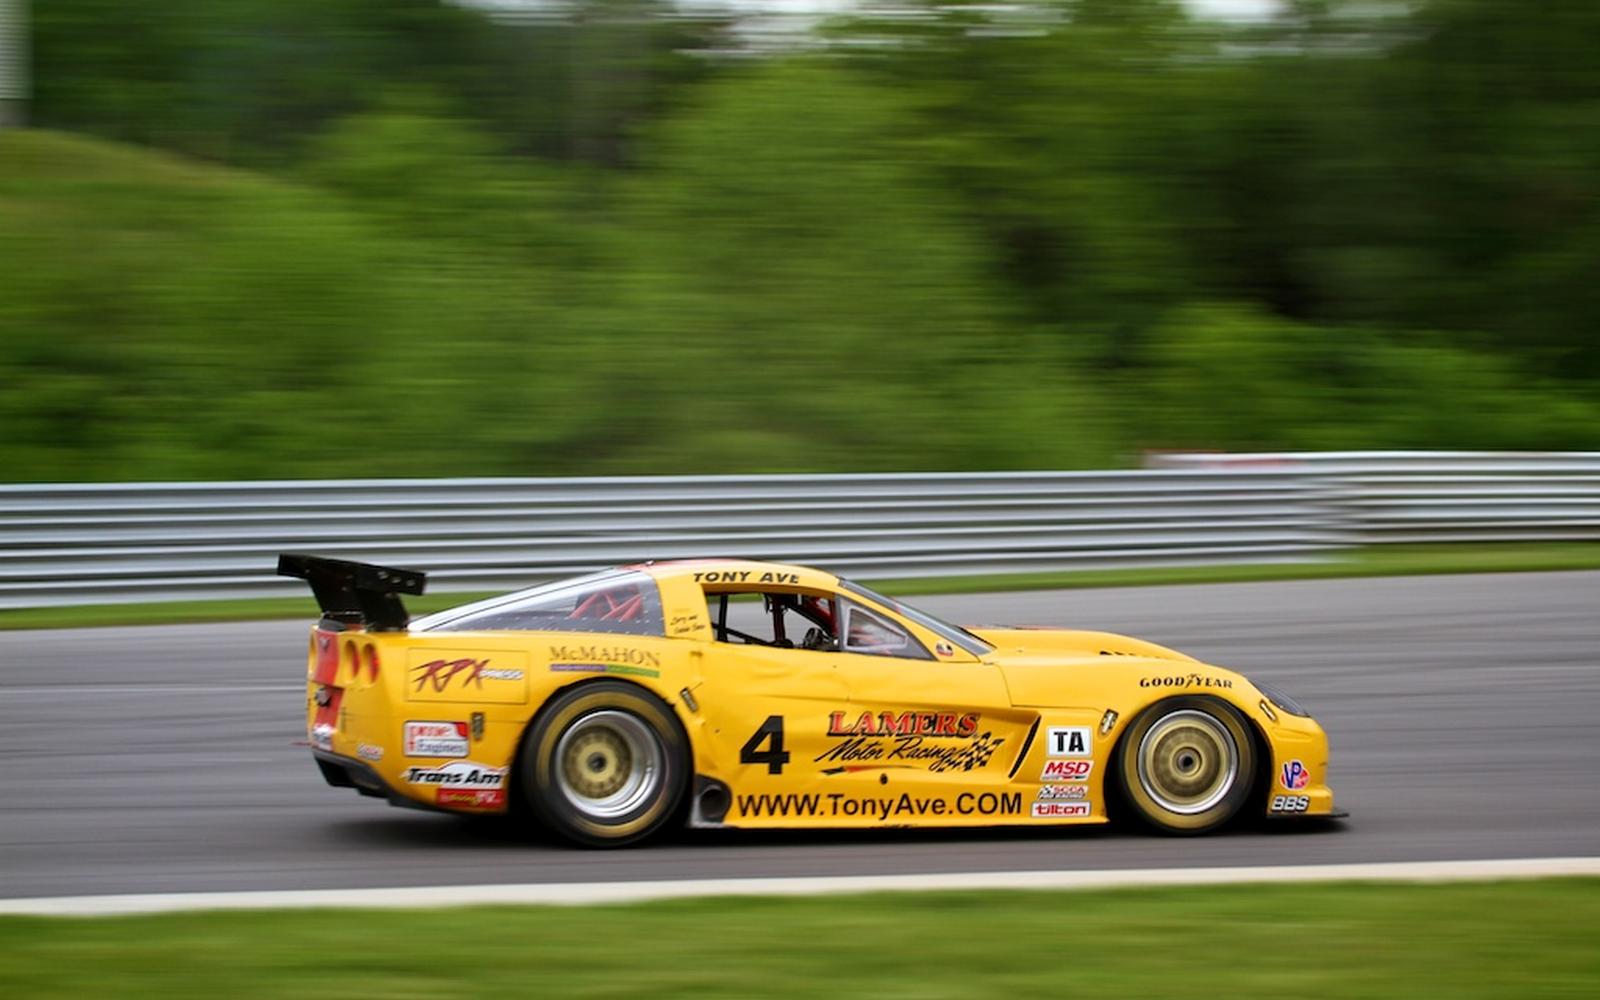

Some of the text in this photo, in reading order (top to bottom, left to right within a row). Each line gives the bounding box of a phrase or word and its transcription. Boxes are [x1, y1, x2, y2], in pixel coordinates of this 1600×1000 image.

[693, 571, 800, 584] TONY AVE
[549, 645, 661, 667] McMAHON
[826, 710, 981, 738] LAMERS
[740, 715, 790, 775] 4
[1053, 731, 1085, 752] TA
[814, 736, 961, 771] Motor Racing
[407, 768, 502, 784] Trans Am
[1045, 761, 1091, 775] MSD
[1284, 761, 1302, 789] VP
[738, 791, 1023, 820] WWW.TonyAve.COM
[1035, 803, 1086, 815] tilton
[1271, 795, 1310, 812] BBS
